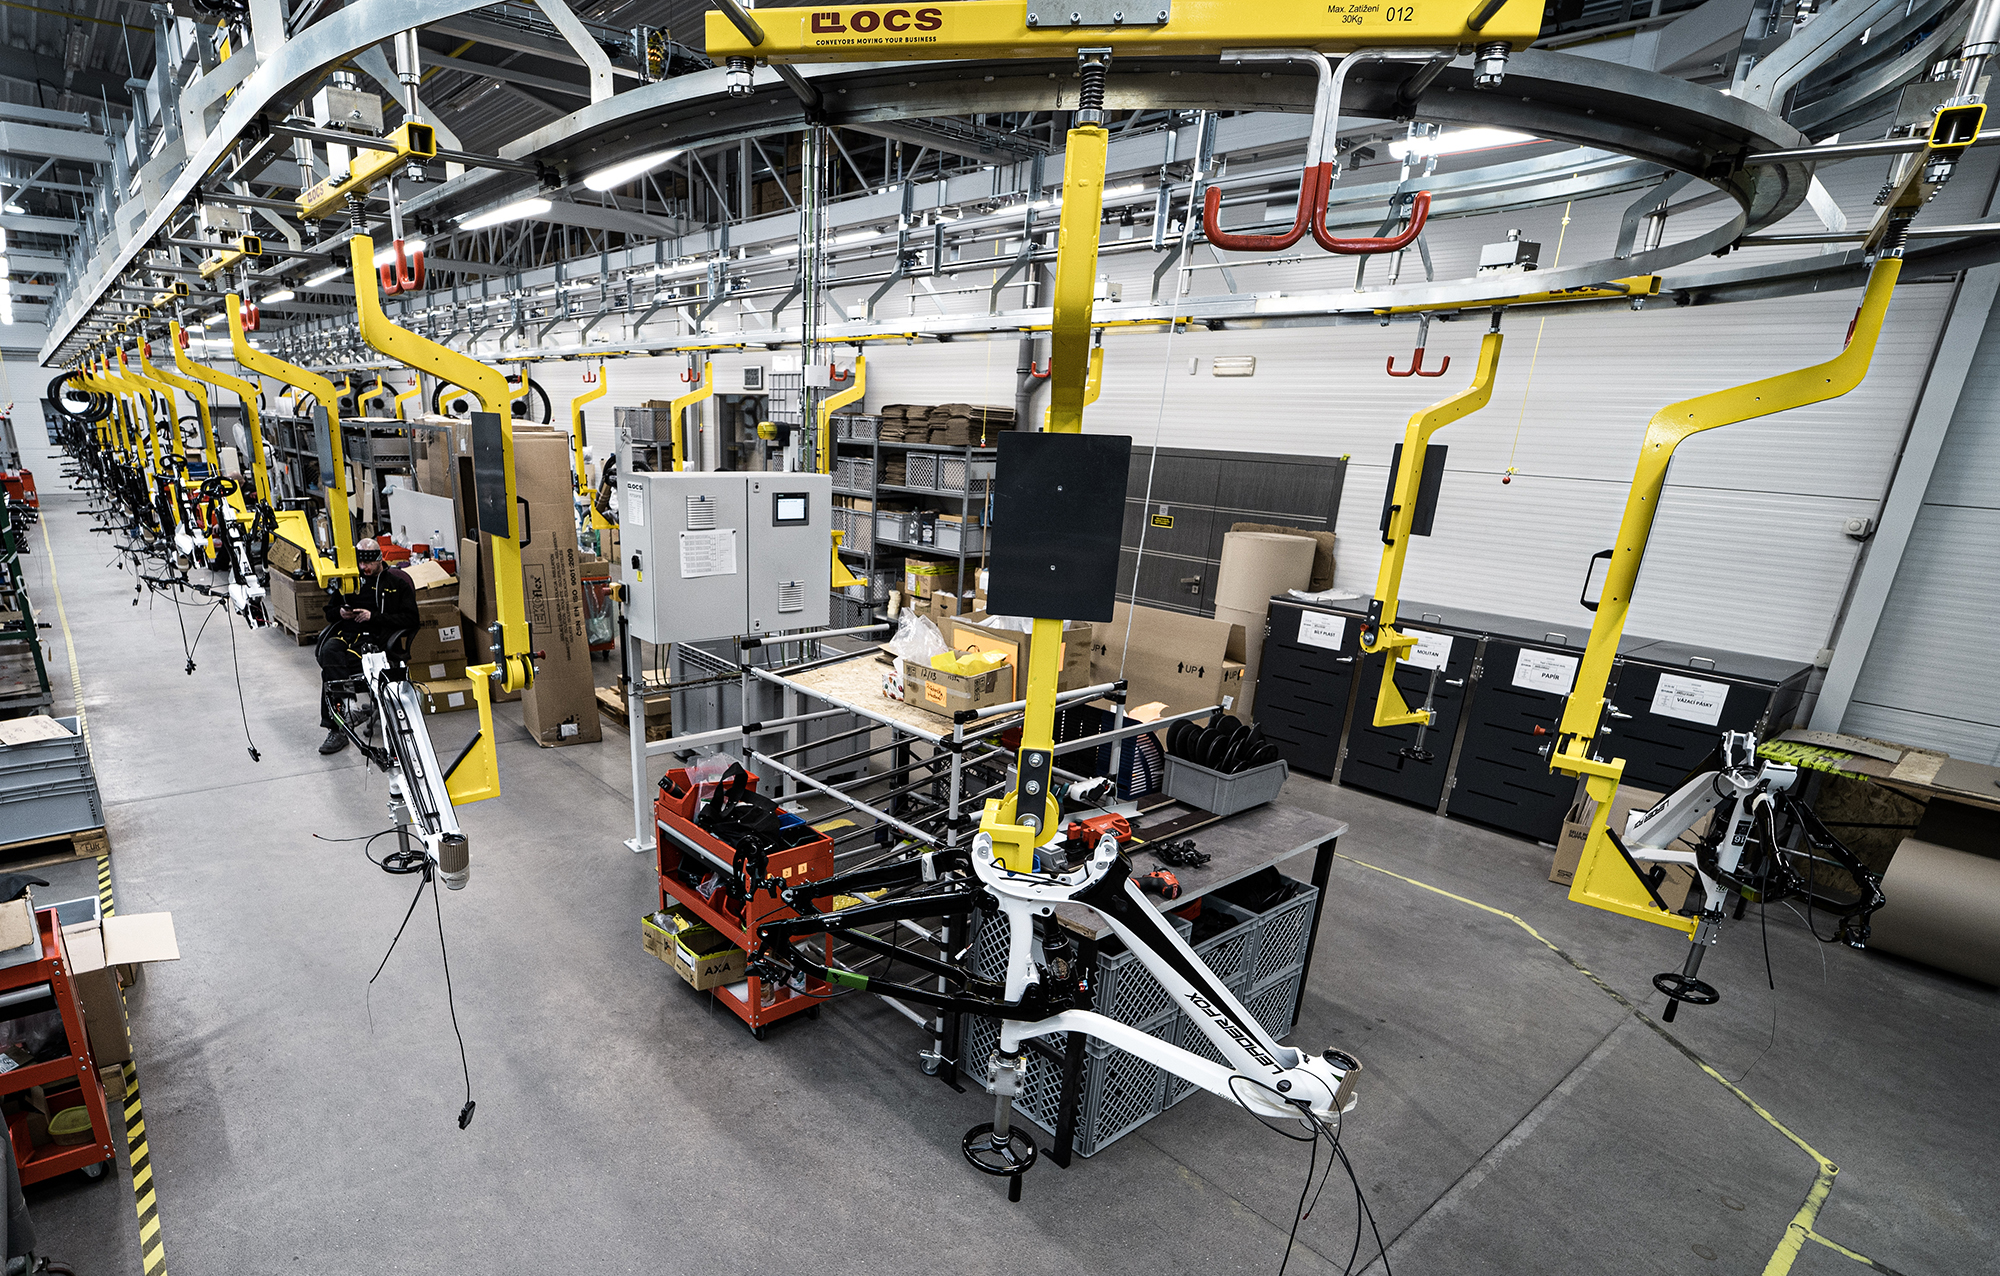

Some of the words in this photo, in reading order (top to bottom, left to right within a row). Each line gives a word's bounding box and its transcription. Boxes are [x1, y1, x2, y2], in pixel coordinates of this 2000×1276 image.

[1327, 4, 1346, 13] Max.
[1348, 4, 1380, 13] Zatížení
[1386, 6, 1414, 22] 012
[1341, 14, 1363, 25] 30Kg
[816, 38, 855, 46] CONVEYORS
[857, 37, 883, 45] MOVING
[566, 548, 576, 586] 9001:2009
[572, 606, 579, 616] EN
[1185, 664, 1198, 674] UP
[1541, 672, 1560, 680] PAPÍR
[1734, 835, 1744, 844] 16
[704, 962, 731, 976] AXA
[1184, 992, 1222, 1017] FOX
[1214, 1018, 1284, 1075] LEADER
